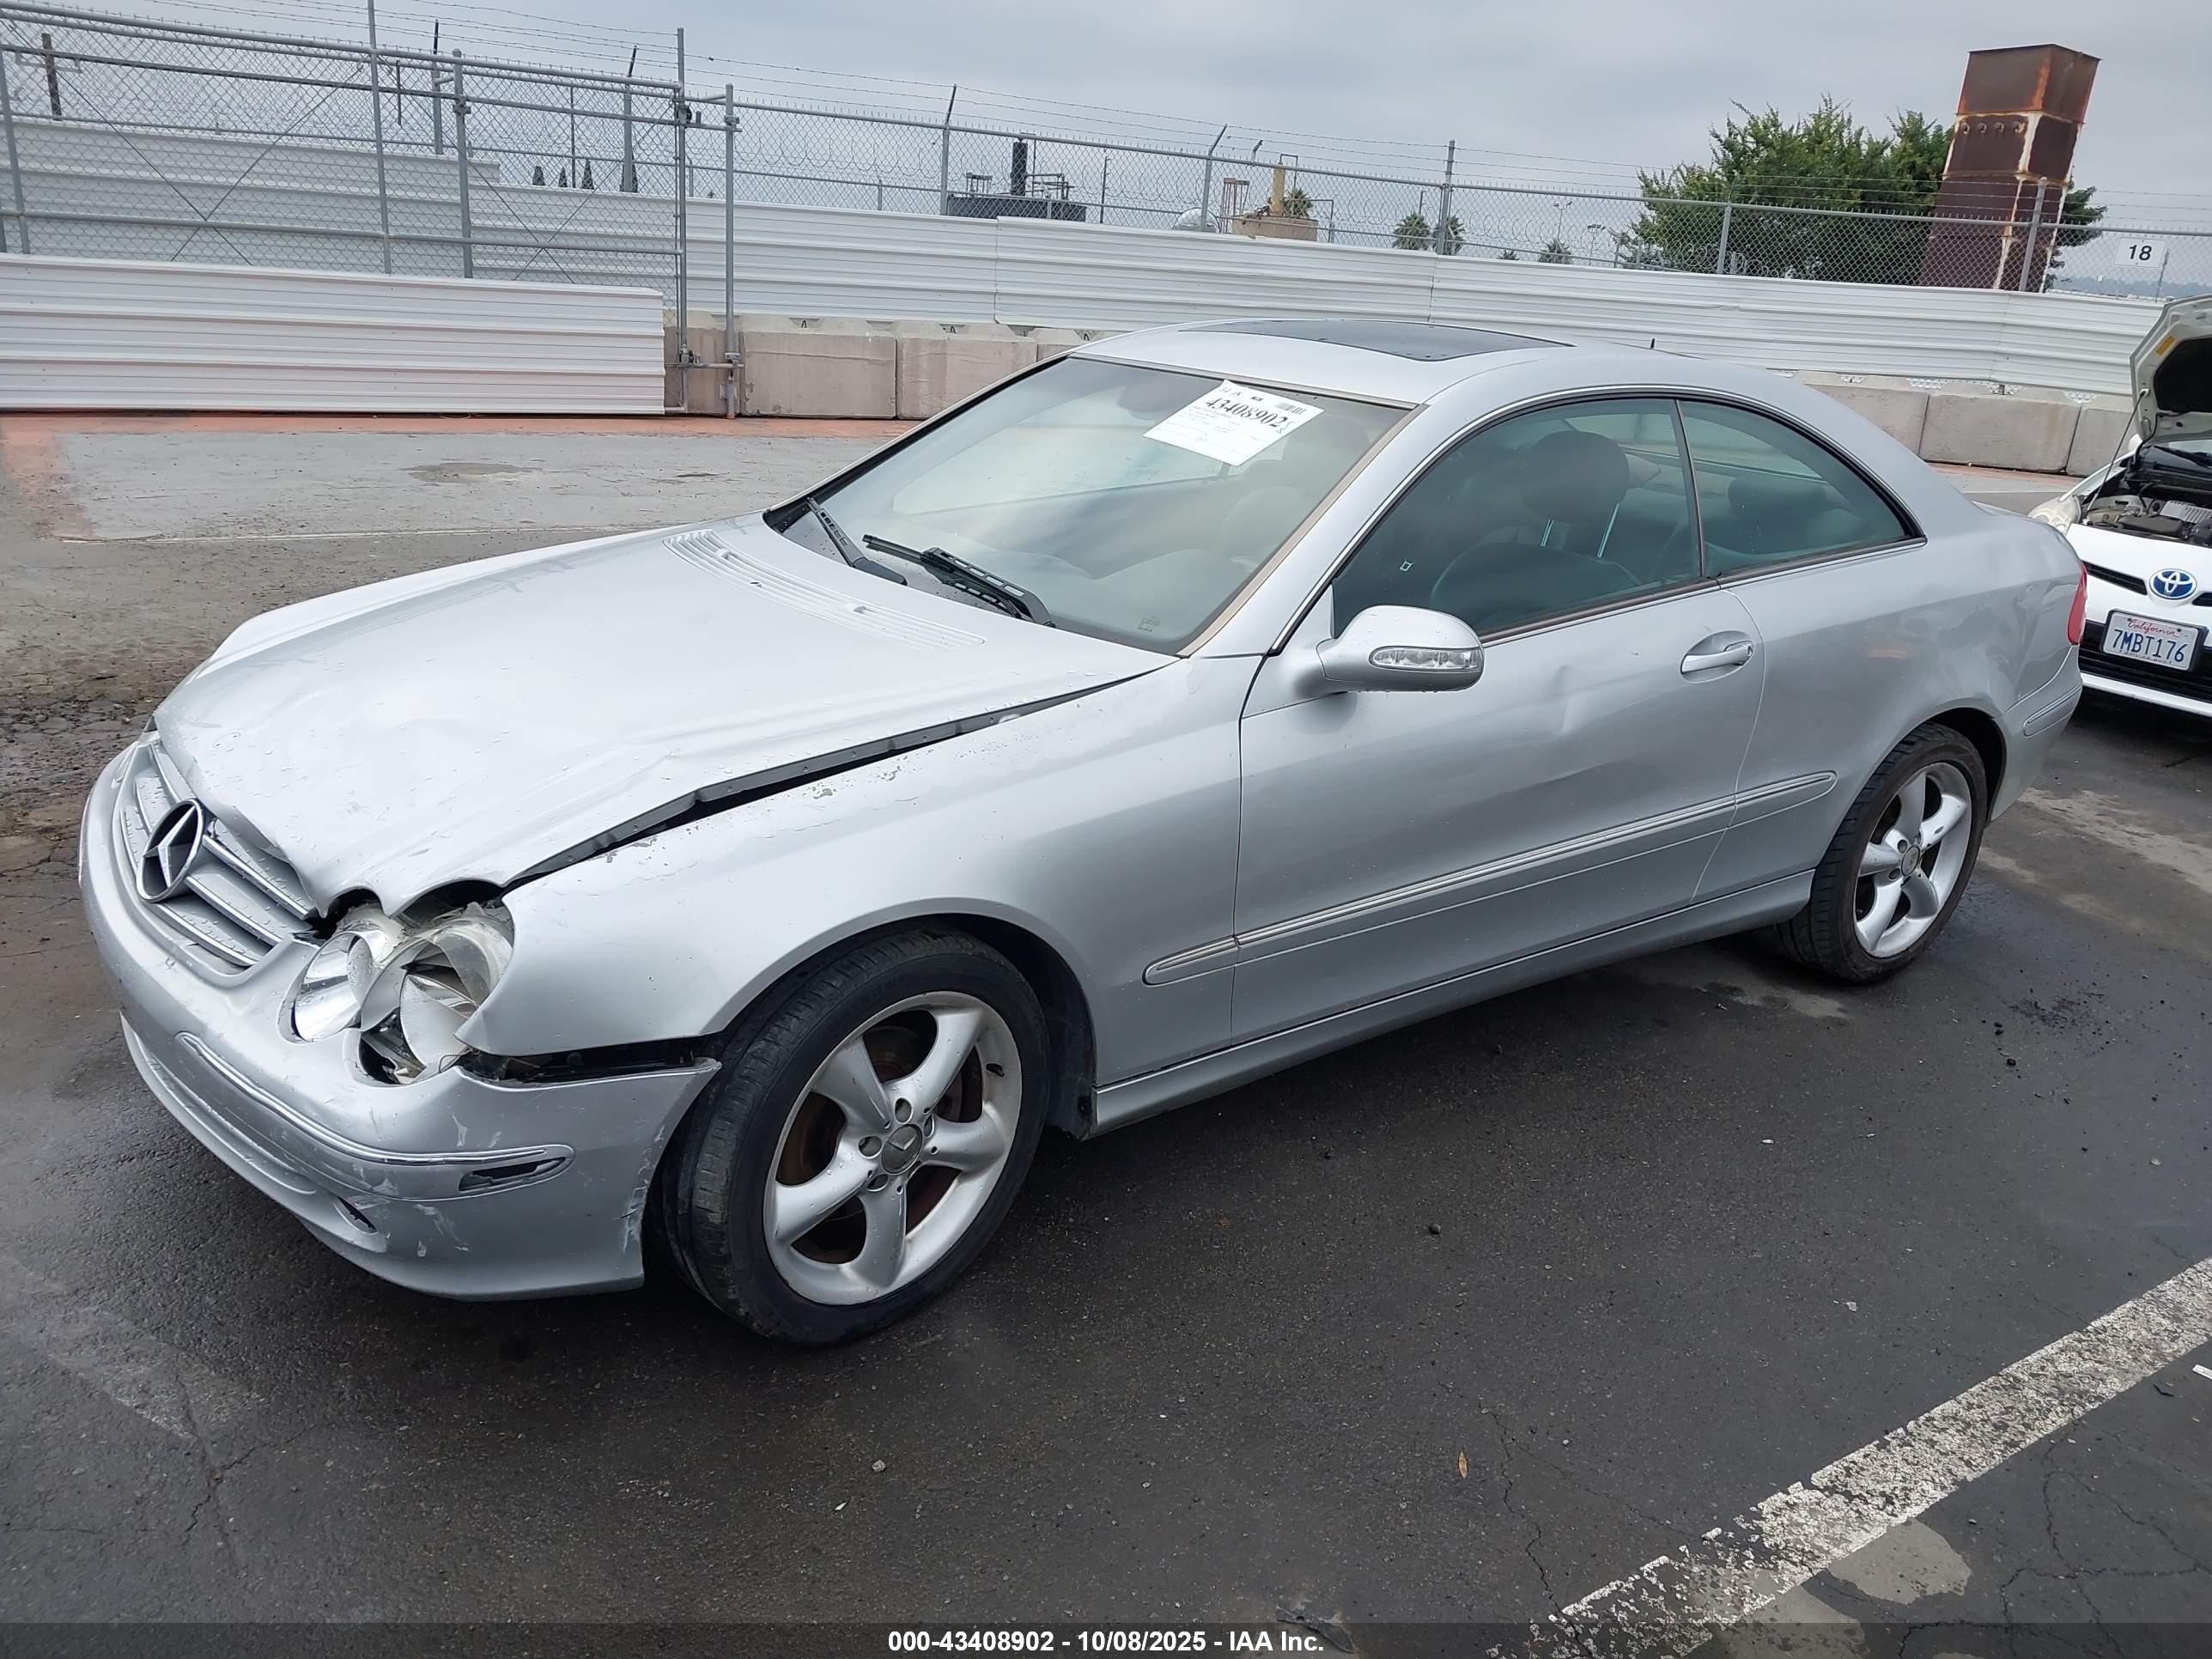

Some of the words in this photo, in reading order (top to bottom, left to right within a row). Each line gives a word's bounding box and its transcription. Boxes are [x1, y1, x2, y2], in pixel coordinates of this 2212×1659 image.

[2129, 244, 2152, 261] 18
[1206, 398, 1288, 428] 43408902
[2129, 619, 2179, 637] California
[2112, 629, 2187, 663] 7MBT176
